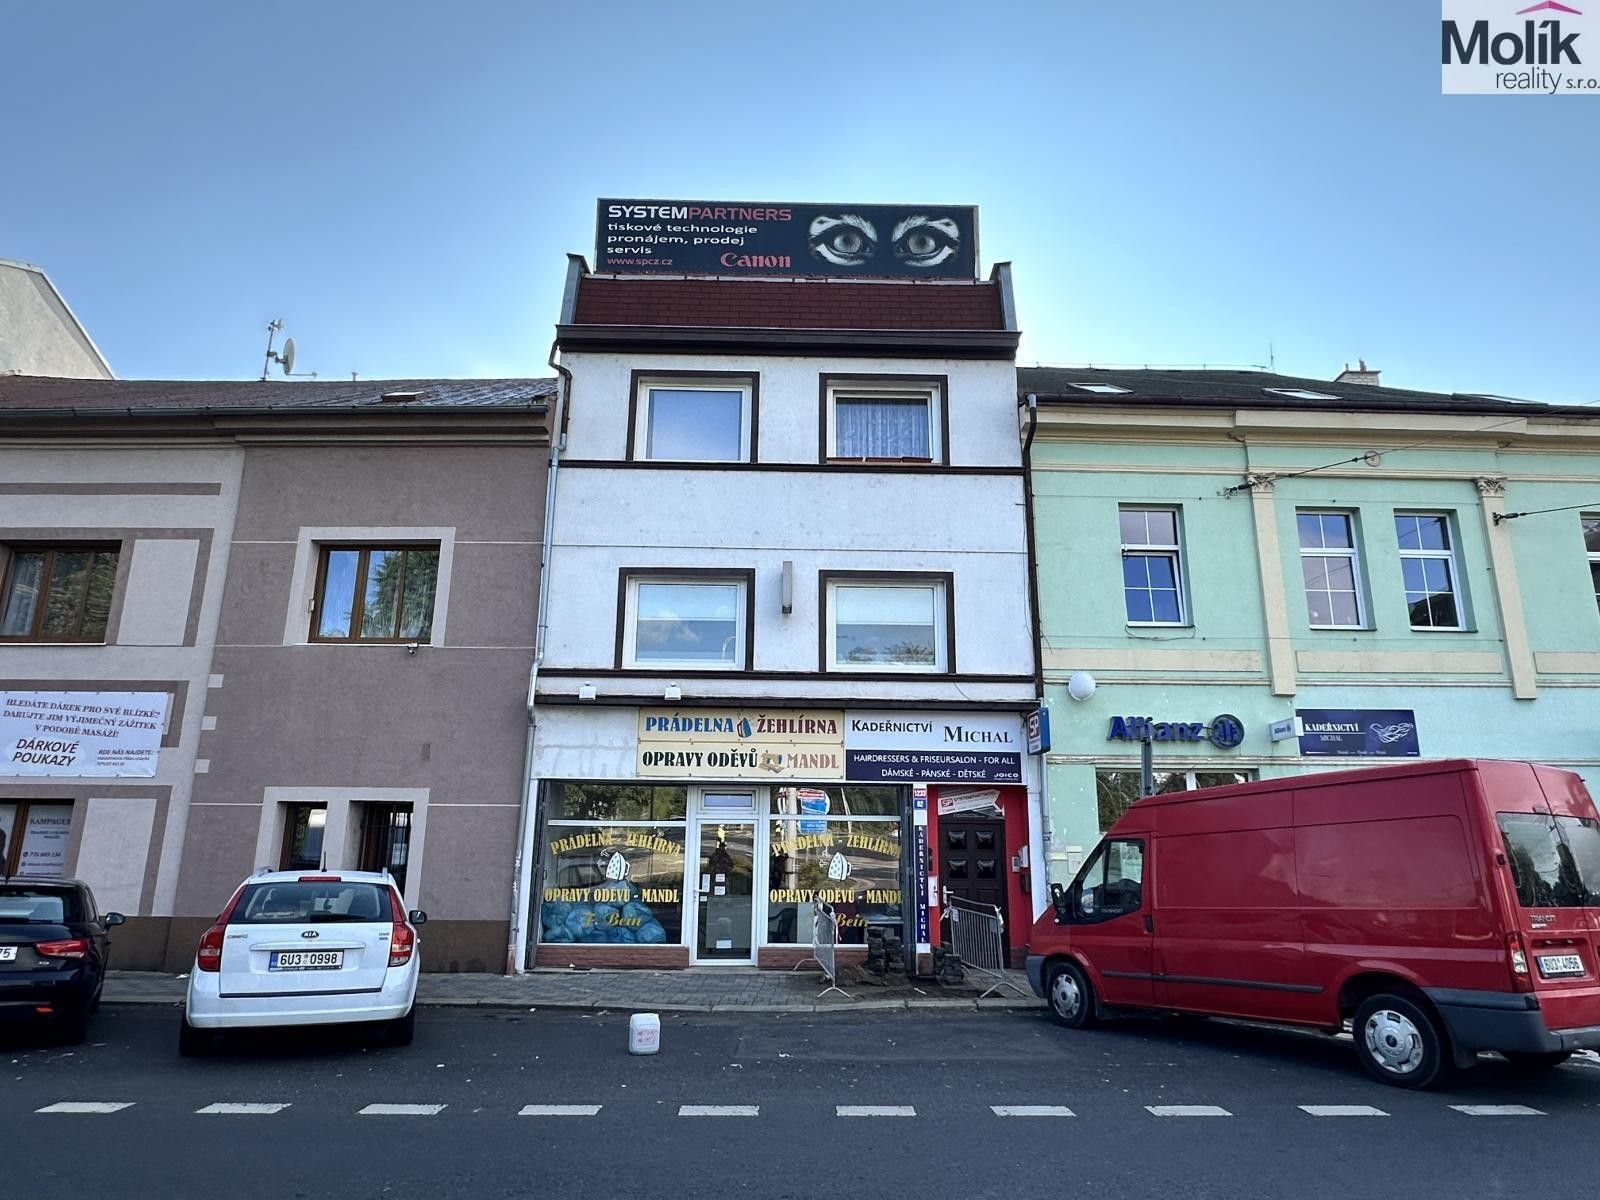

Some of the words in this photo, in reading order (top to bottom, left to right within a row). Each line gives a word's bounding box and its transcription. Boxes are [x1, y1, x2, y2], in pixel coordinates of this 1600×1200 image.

[608, 205, 792, 221] SYSTEMPARTNERS
[607, 223, 662, 232] tiskové
[667, 224, 758, 234] technologie
[607, 235, 688, 245] pronájem,
[693, 236, 744, 246] prodej
[607, 246, 652, 254] servis
[607, 258, 673, 266] www.spcz.cz
[720, 252, 791, 268] Canon
[6, 699, 49, 709] HLEDÁTE
[50, 702, 81, 712] DÁREK
[83, 705, 102, 713] PRO
[104, 706, 121, 715] SVÉ
[123, 708, 161, 718] BLÍZKÉ?
[3, 710, 45, 720] DARUJTE
[46, 713, 63, 721] JIM
[66, 714, 117, 726] VÝJIMEČNÝ
[118, 719, 157, 730] ZÁŽITEK
[645, 712, 734, 733] PRÁDELNA
[756, 714, 837, 734] ŽEHLÍRNA
[1029, 715, 1039, 737] SP
[1305, 722, 1359, 732] KADEŘNICTVÍ
[1106, 716, 1206, 743] Allianz
[16, 737, 80, 754] DÁRKOVÉ
[12, 751, 76, 767] POUKAZY
[642, 751, 704, 767] OPRAVY
[707, 747, 758, 768] ODĚVŮ
[787, 753, 840, 769] MANDL
[853, 754, 910, 763] HAIRDRESSERS
[920, 756, 977, 764] FRISEURSALON
[984, 756, 1000, 765] FOR
[1001, 756, 1015, 765] ALL
[881, 767, 914, 777] DÁMSKÉ
[921, 767, 951, 778] PÁNSKÉ
[958, 768, 986, 778] DĚTSKÉ
[550, 832, 612, 856] PRÁDELNA
[544, 888, 591, 902] OPRAVY
[641, 888, 680, 903] MANDL
[769, 889, 815, 903] OPRAVY
[280, 954, 301, 966] 6U3
[309, 954, 338, 965] 0998
